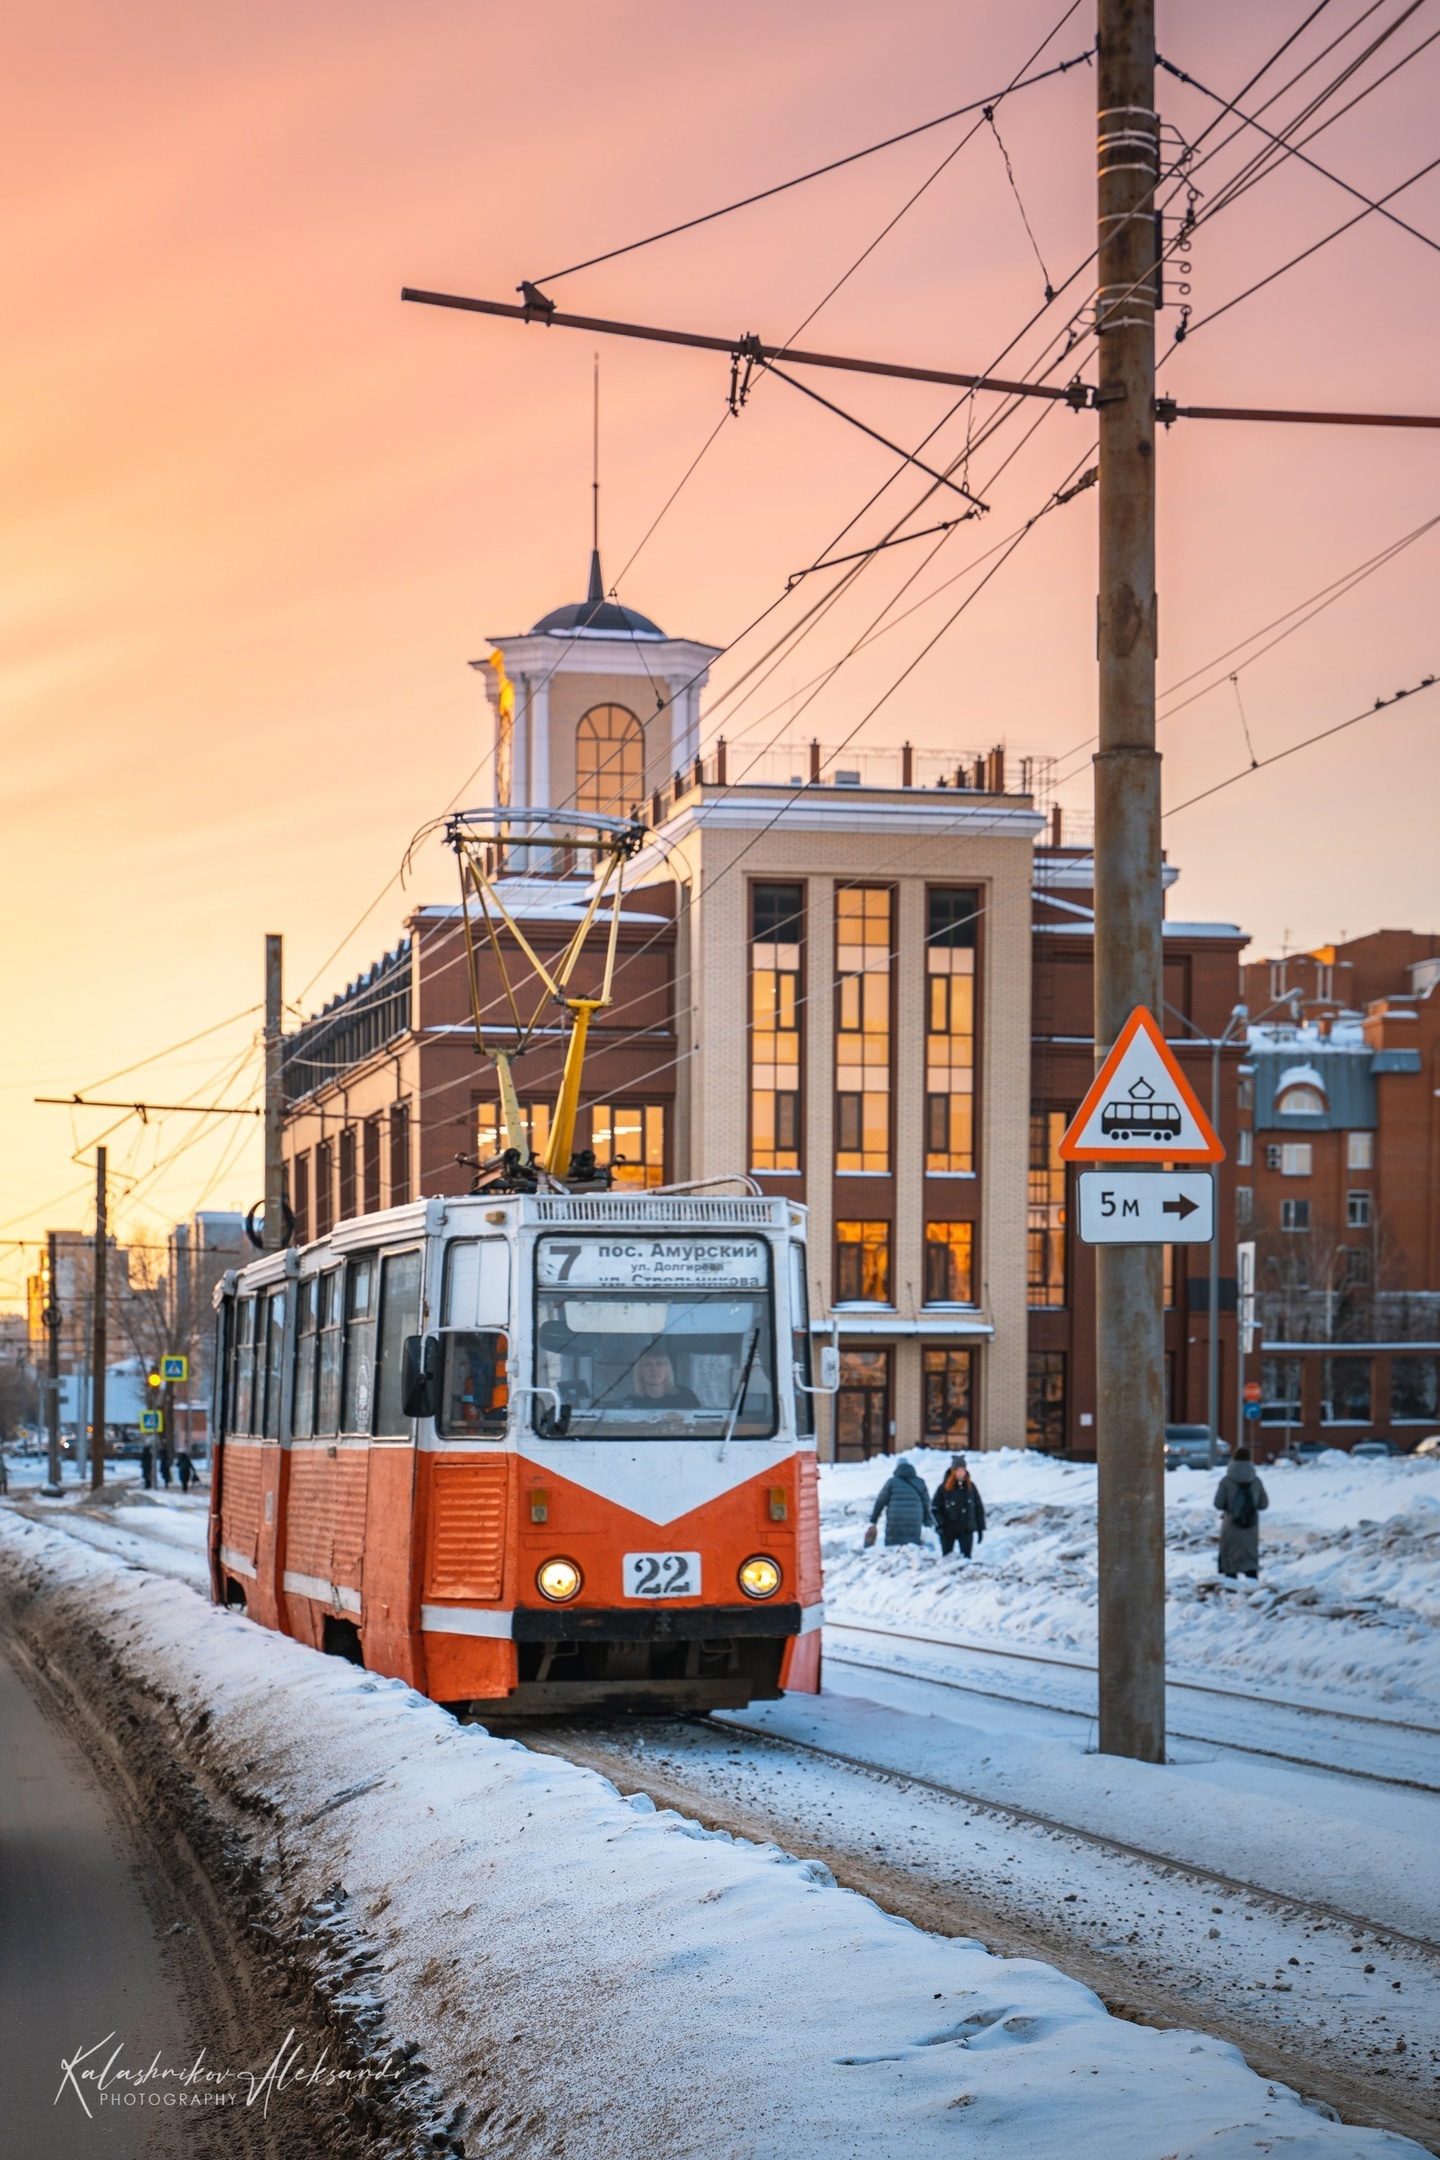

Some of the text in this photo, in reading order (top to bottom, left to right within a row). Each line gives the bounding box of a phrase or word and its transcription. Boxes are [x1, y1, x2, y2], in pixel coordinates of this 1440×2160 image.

[1101, 1191, 1116, 1217] 5
[549, 1245, 582, 1285] 7
[598, 1243, 758, 1261] пос. Амурский
[631, 1264, 650, 1273] ул.
[634, 1556, 690, 1594] 22
